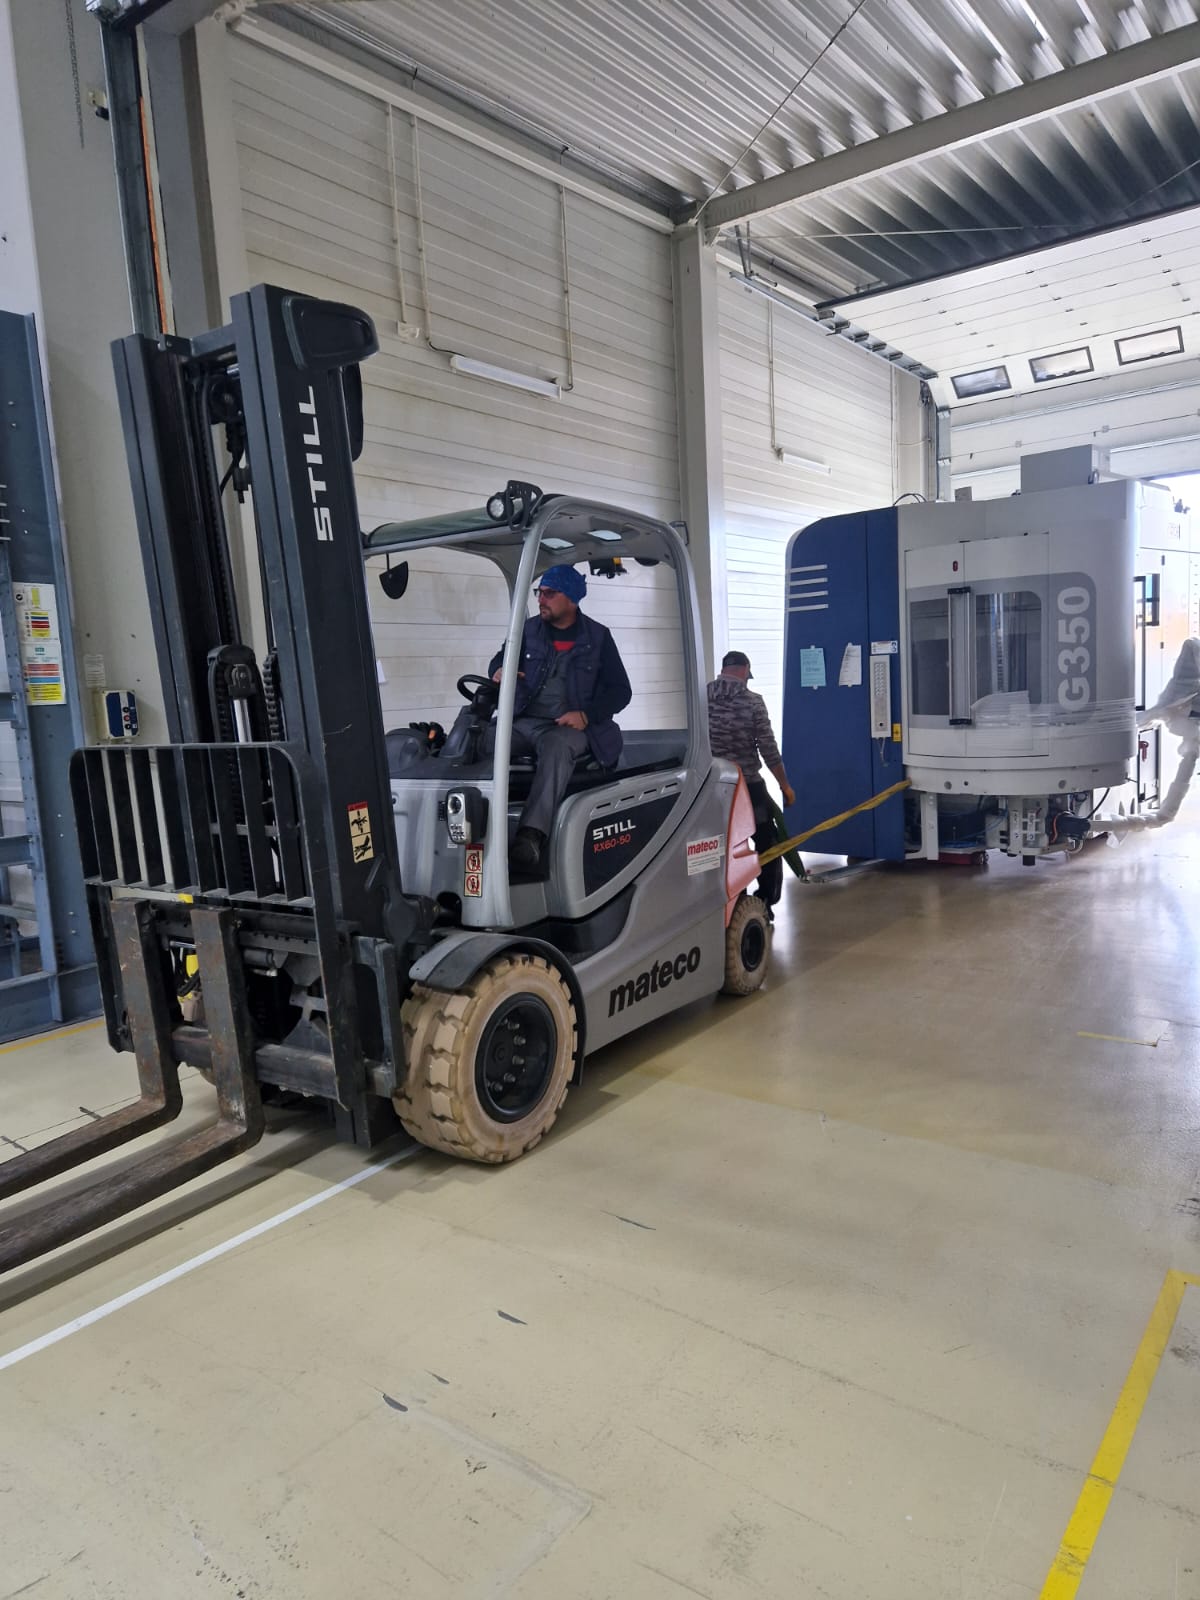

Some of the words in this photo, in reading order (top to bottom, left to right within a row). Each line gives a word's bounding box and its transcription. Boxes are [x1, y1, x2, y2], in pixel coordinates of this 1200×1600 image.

[299, 385, 334, 542] STILL
[1056, 586, 1091, 712] G350
[592, 819, 637, 841] STILL
[592, 833, 632, 854] RX60-50
[687, 839, 719, 857] mateco
[608, 945, 701, 1018] mateco
